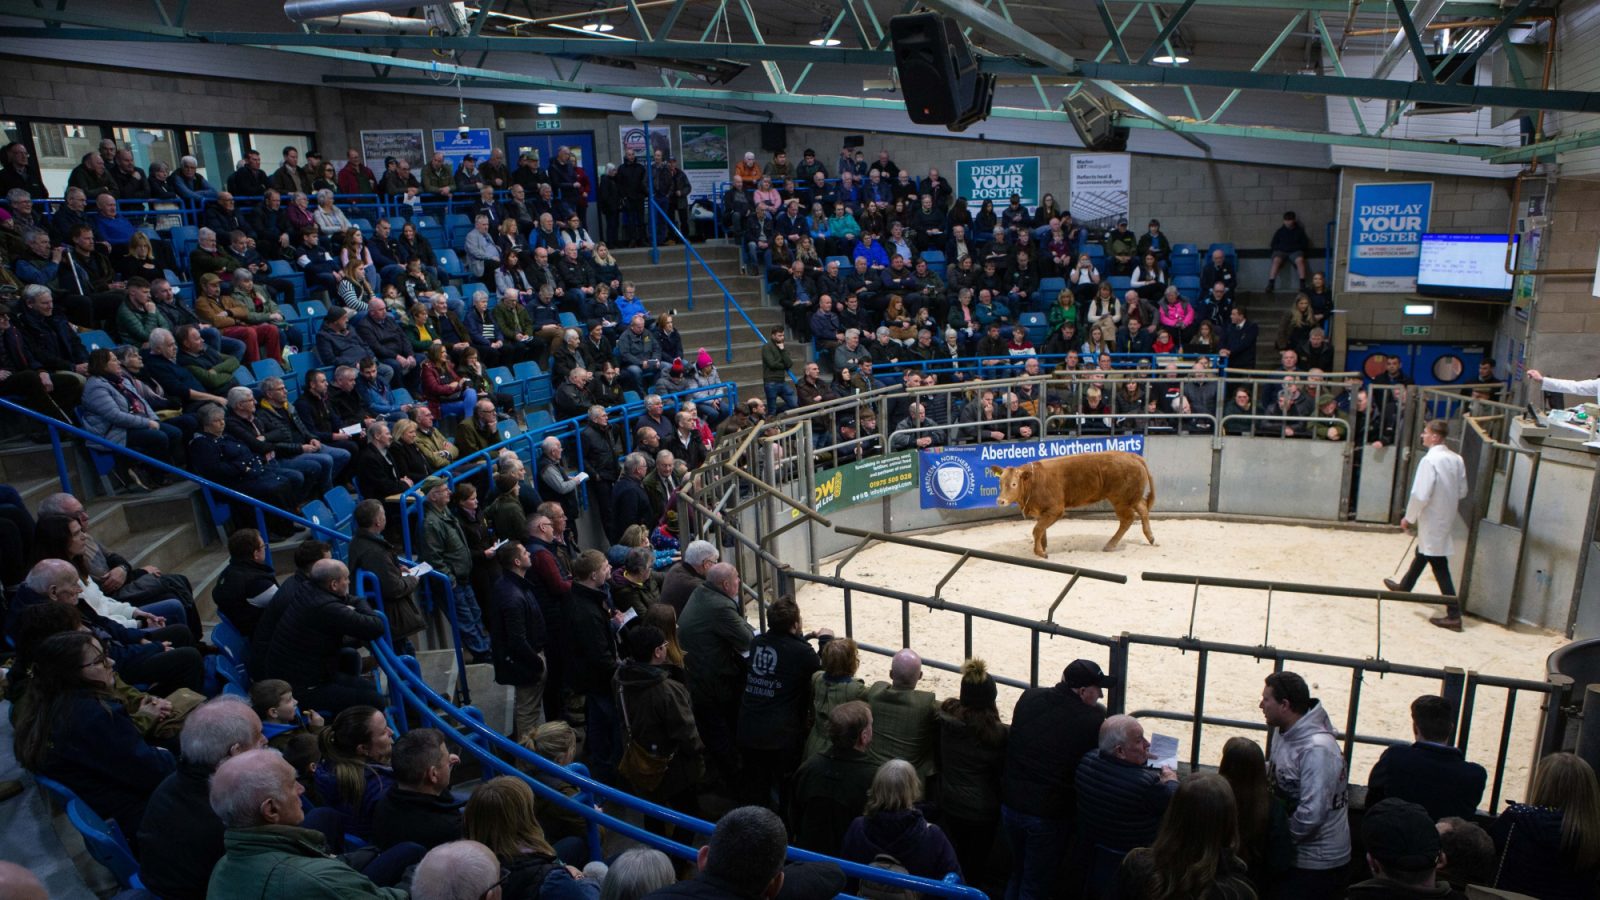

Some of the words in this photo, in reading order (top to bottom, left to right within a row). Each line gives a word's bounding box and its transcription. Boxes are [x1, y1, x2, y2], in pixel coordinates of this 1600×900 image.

[971, 164, 1024, 176] DISPLAY
[971, 174, 1024, 189] YOUR
[971, 187, 1023, 199] POSTER
[1361, 204, 1423, 216] DISPLAY
[1358, 216, 1422, 232] YOUR
[1360, 231, 1418, 243] POSTER
[981, 444, 1036, 461] Aberdeen
[1037, 442, 1049, 457] &
[1050, 437, 1103, 457] Northern
[1106, 437, 1141, 452] Marts
[940, 455, 972, 472] NORTHERN
[869, 478, 887, 488] 01975
[980, 484, 998, 497] from
[822, 494, 833, 506] Ltd
